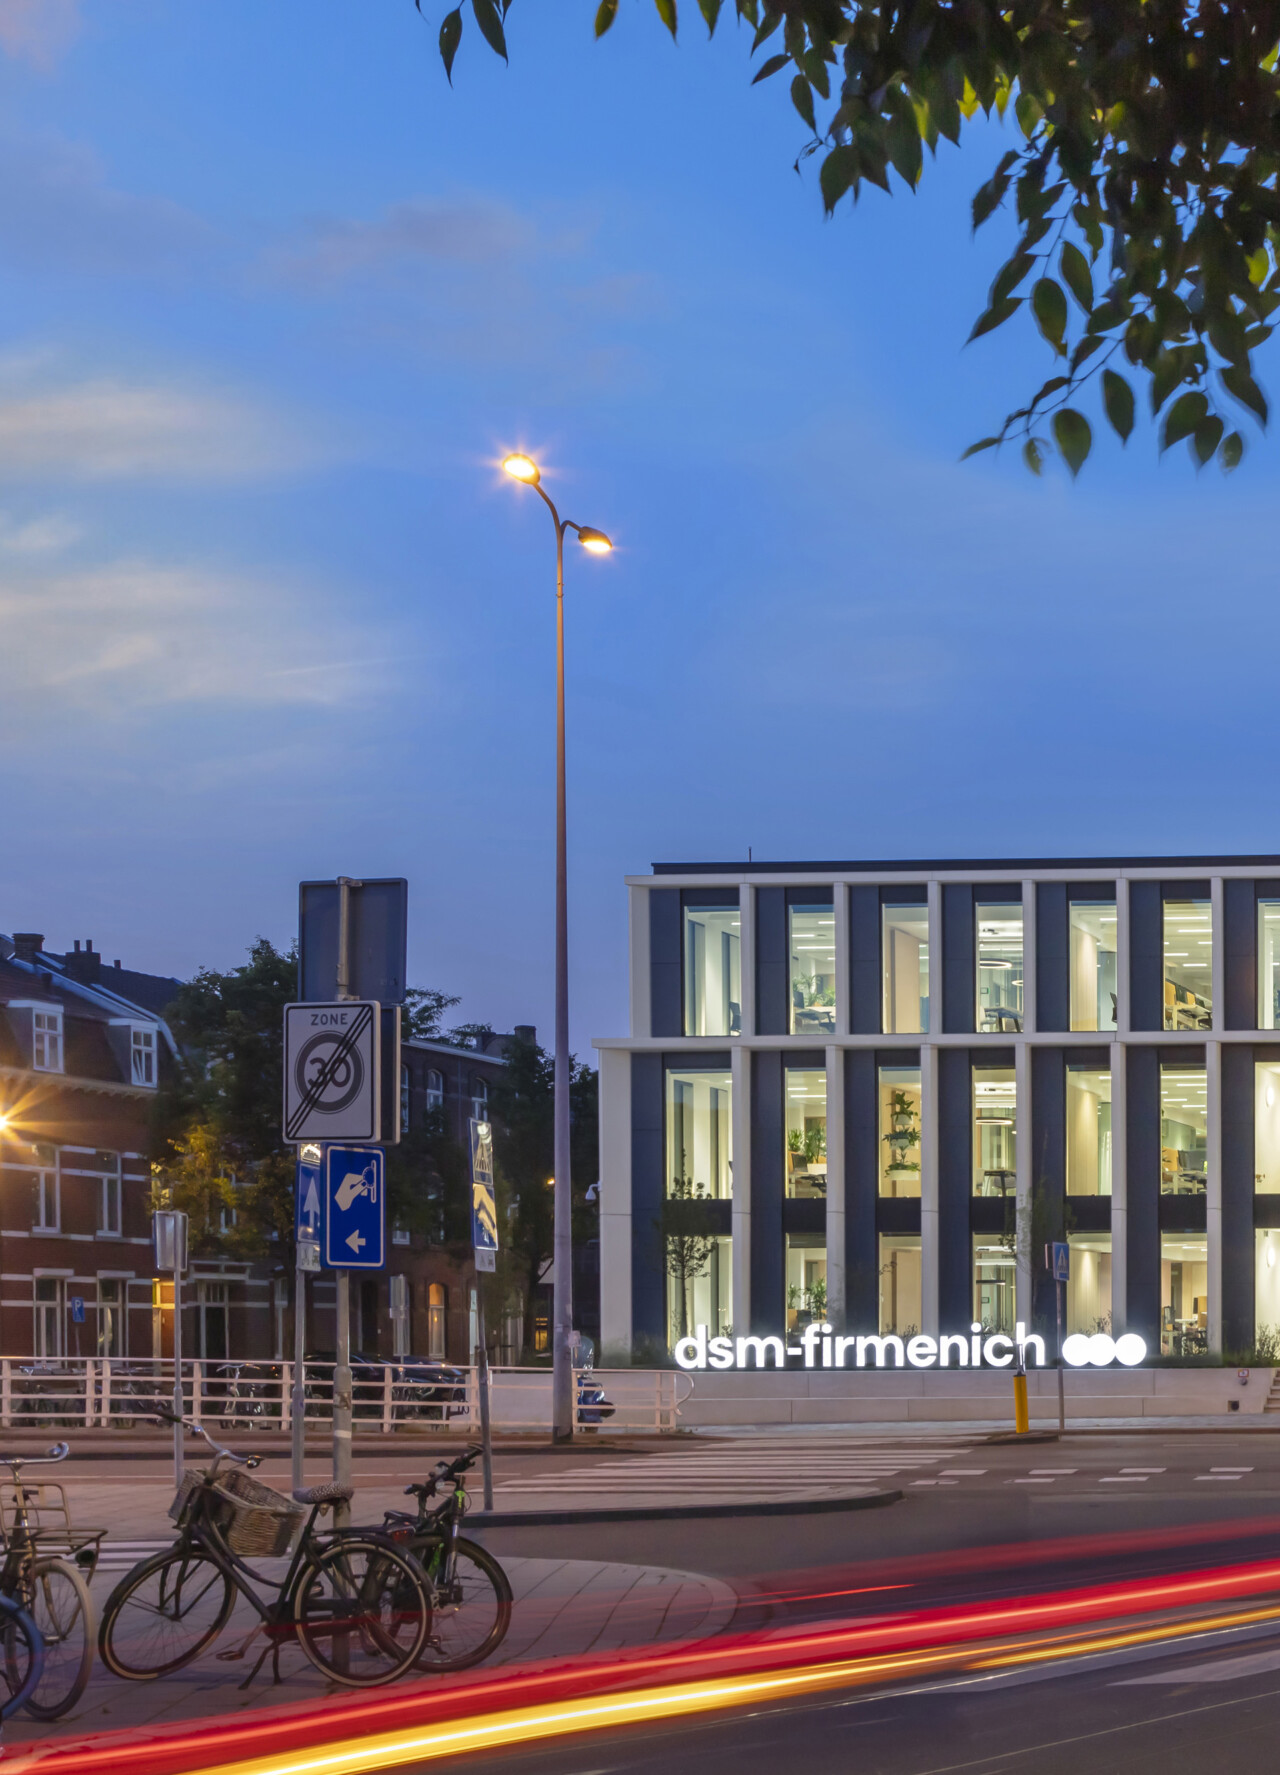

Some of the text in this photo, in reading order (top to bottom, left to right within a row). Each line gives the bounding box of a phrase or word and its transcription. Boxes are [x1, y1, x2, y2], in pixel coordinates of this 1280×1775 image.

[311, 1013, 348, 1026] ZONE
[308, 1057, 352, 1088] 30
[75, 1299, 81, 1311] P
[673, 1321, 1045, 1369] dsm-firmenich
